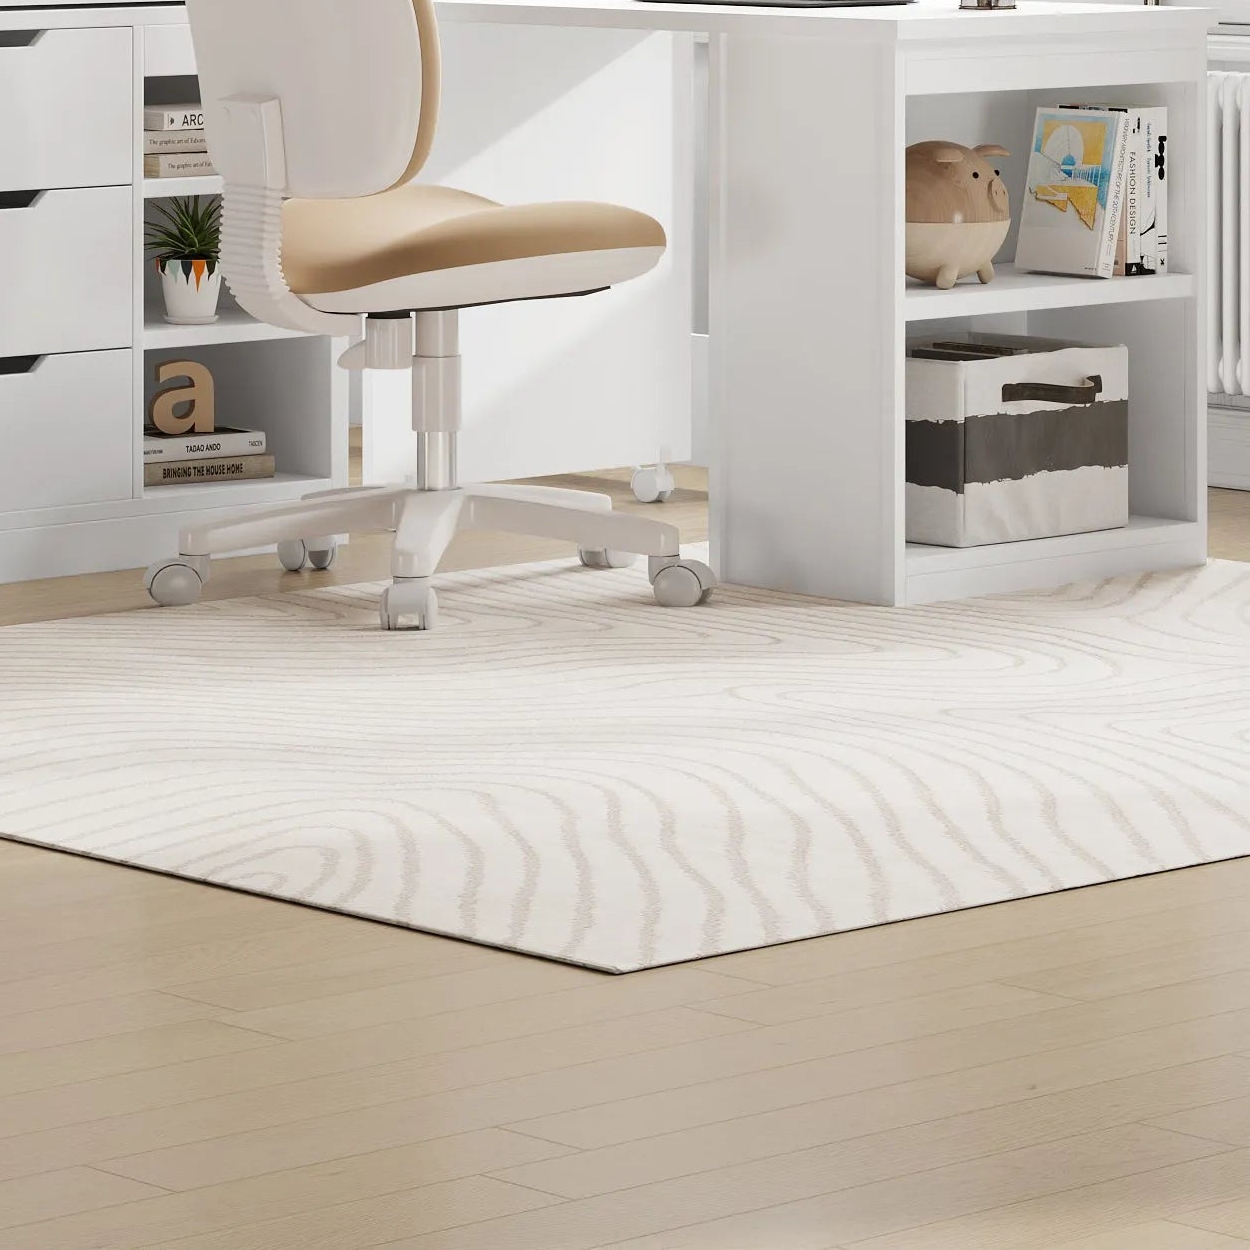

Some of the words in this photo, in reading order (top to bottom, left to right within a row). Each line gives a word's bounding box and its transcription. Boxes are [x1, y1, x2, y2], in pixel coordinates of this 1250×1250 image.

[1129, 198, 1137, 235] DESIGN
[148, 358, 215, 435] a
[185, 444, 205, 453] TADAO
[205, 443, 221, 451] ANDO
[162, 468, 192, 479] BRINGING
[192, 466, 205, 477] THE
[205, 464, 226, 476] HOUSE
[226, 463, 243, 474] HOME
